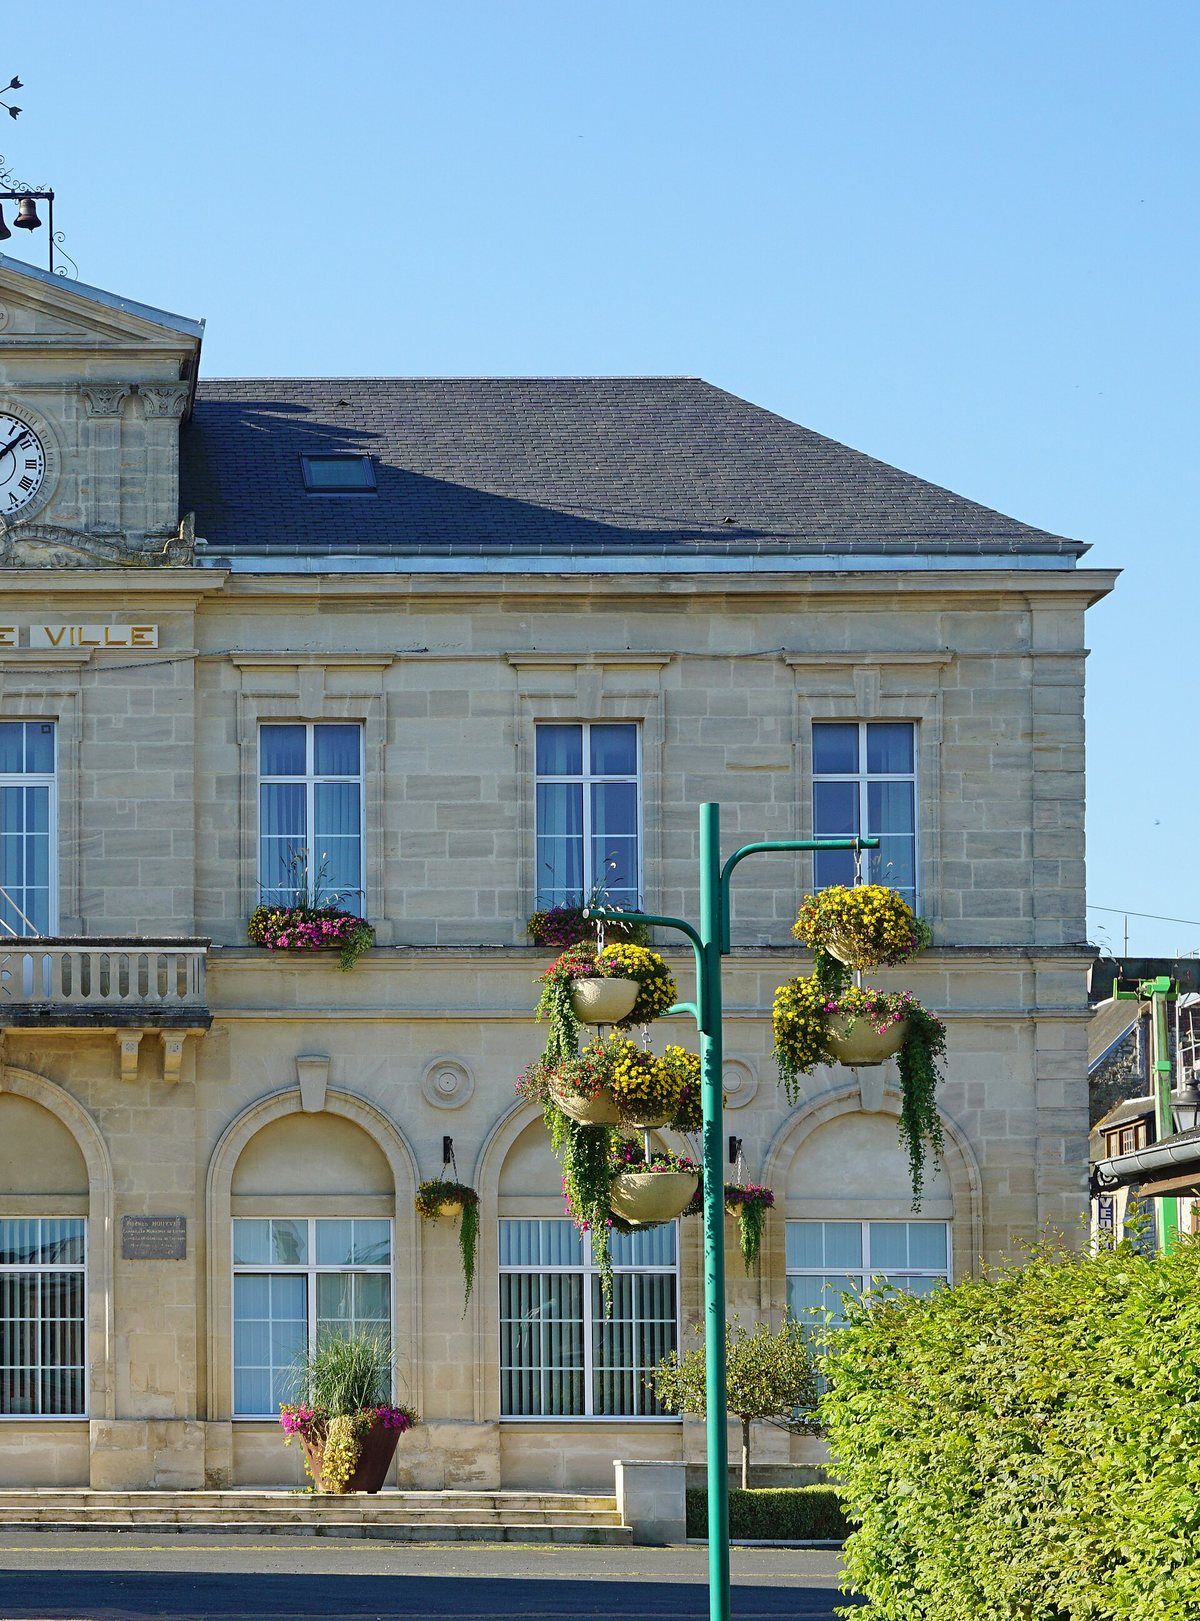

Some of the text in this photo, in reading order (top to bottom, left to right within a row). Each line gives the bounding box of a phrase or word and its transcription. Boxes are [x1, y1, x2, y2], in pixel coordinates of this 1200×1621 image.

[8, 425, 17, 436] I
[20, 439, 33, 451] II
[25, 459, 37, 470] III
[18, 475, 34, 491] IIII
[8, 492, 18, 504] V
[43, 626, 155, 647] VILLE
